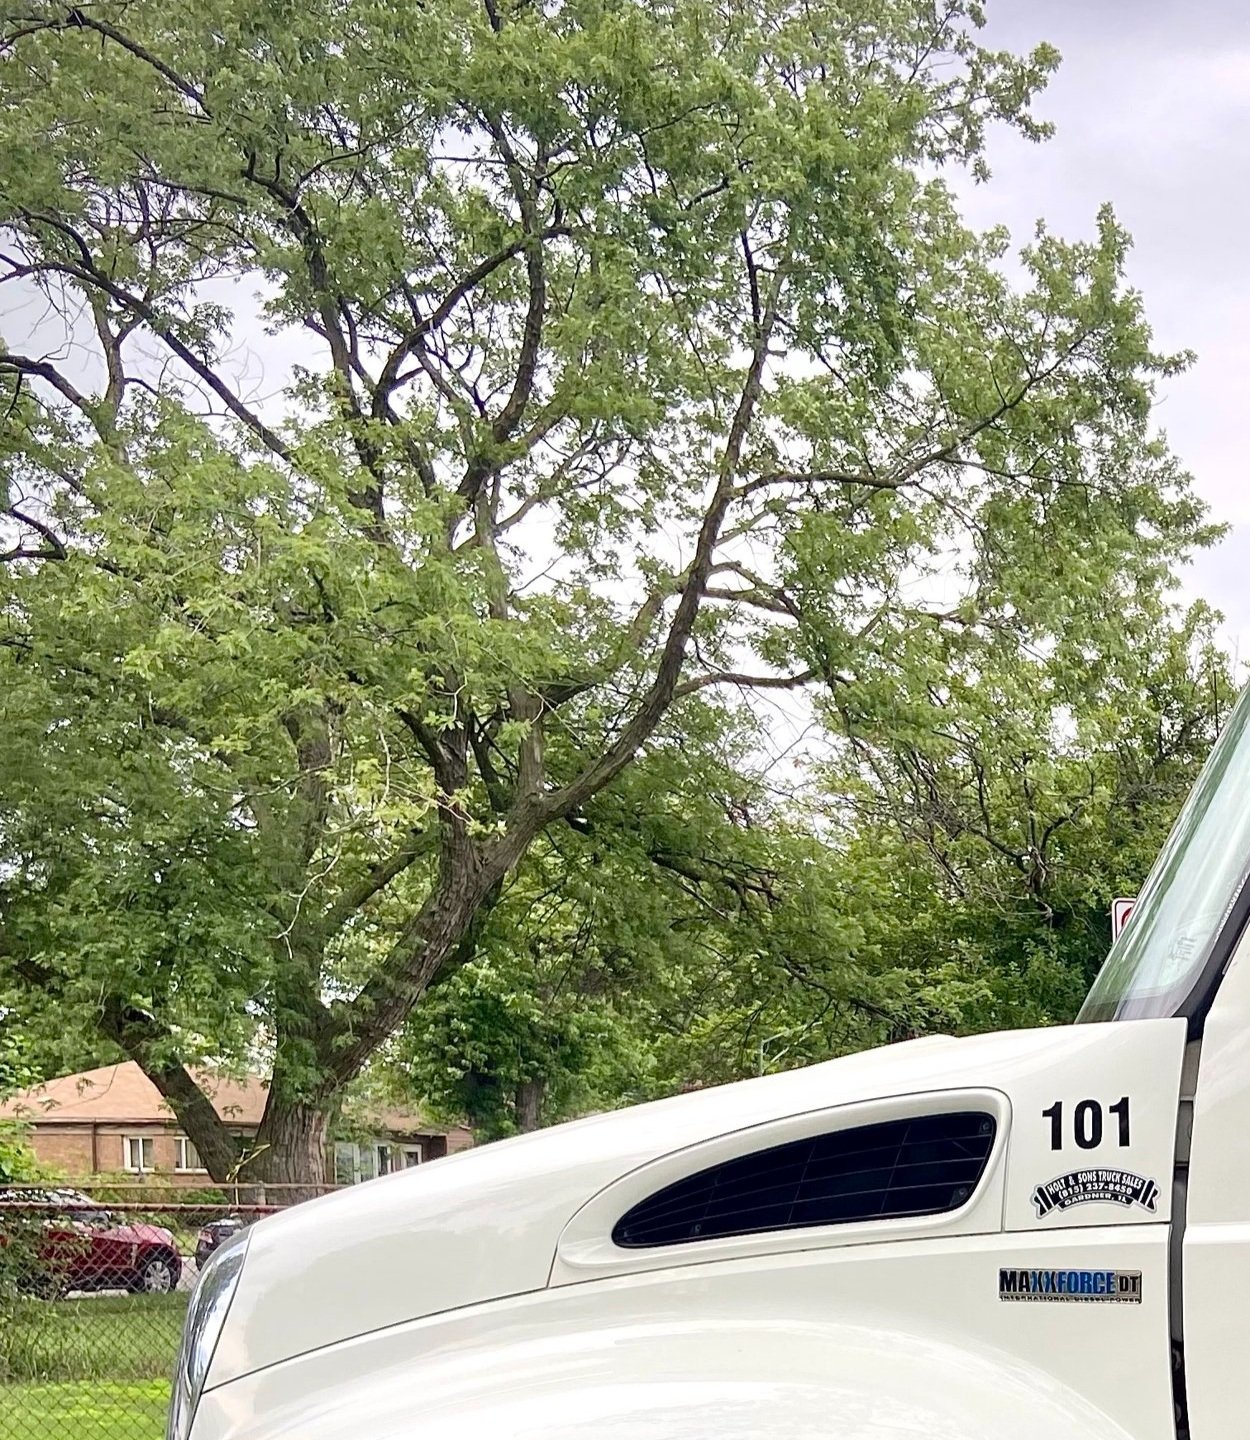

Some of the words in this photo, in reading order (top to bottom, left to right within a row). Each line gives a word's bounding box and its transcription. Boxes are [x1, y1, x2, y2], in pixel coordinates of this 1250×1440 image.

[1042, 1096, 1130, 1151] 101
[1068, 1175, 1076, 1186] &
[1077, 1171, 1097, 1183] SONS
[1098, 1171, 1121, 1182] TRUCK
[1121, 1174, 1143, 1190] SALES
[1058, 1184, 1083, 1199] (815)
[999, 1270, 1116, 1294] MAXXFORCE
[1119, 1276, 1139, 1292] DT
